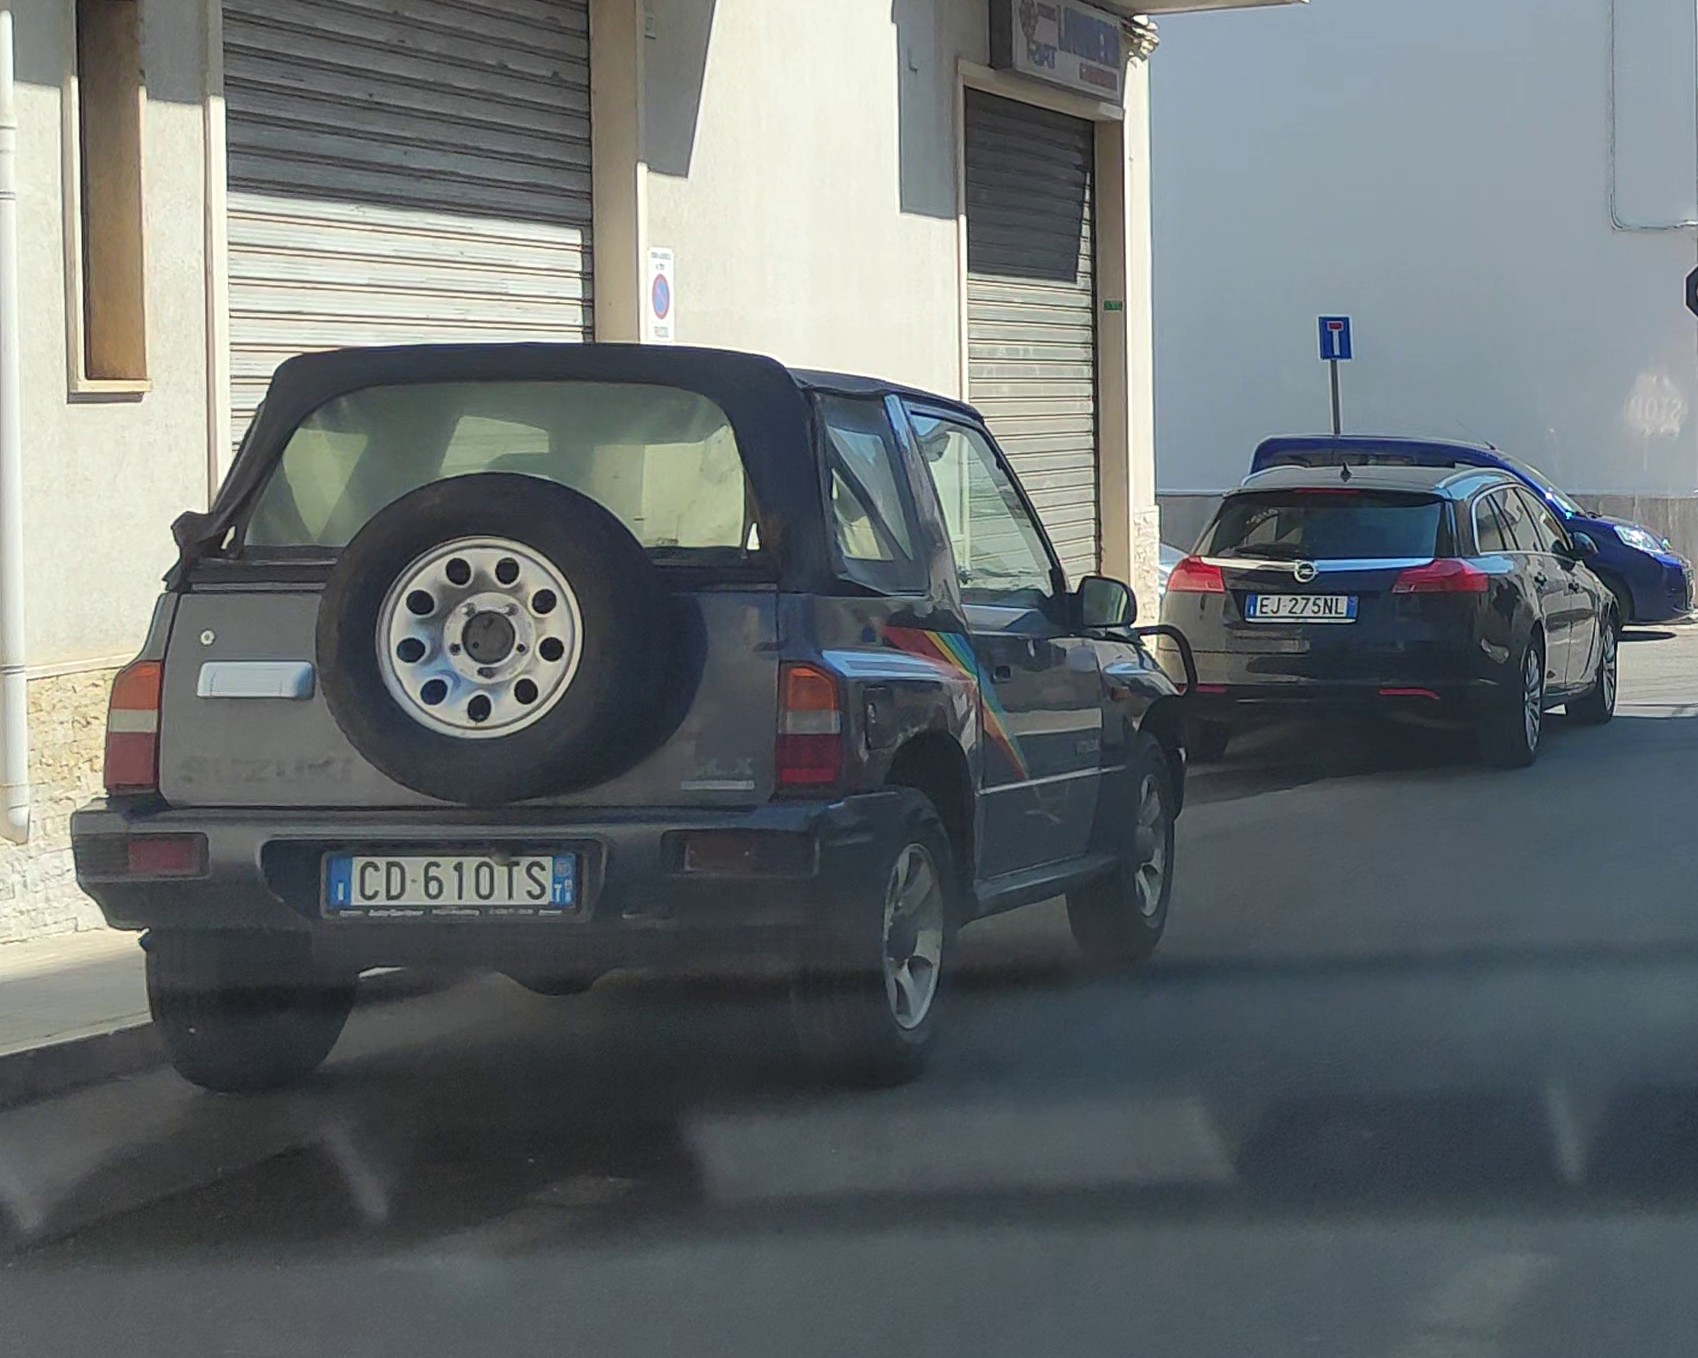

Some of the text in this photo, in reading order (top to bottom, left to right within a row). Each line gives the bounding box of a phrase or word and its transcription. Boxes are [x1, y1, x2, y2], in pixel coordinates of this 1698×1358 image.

[1259, 597, 1345, 615] EJ 275NL
[359, 860, 407, 901] CD
[424, 860, 547, 901] 610TS
